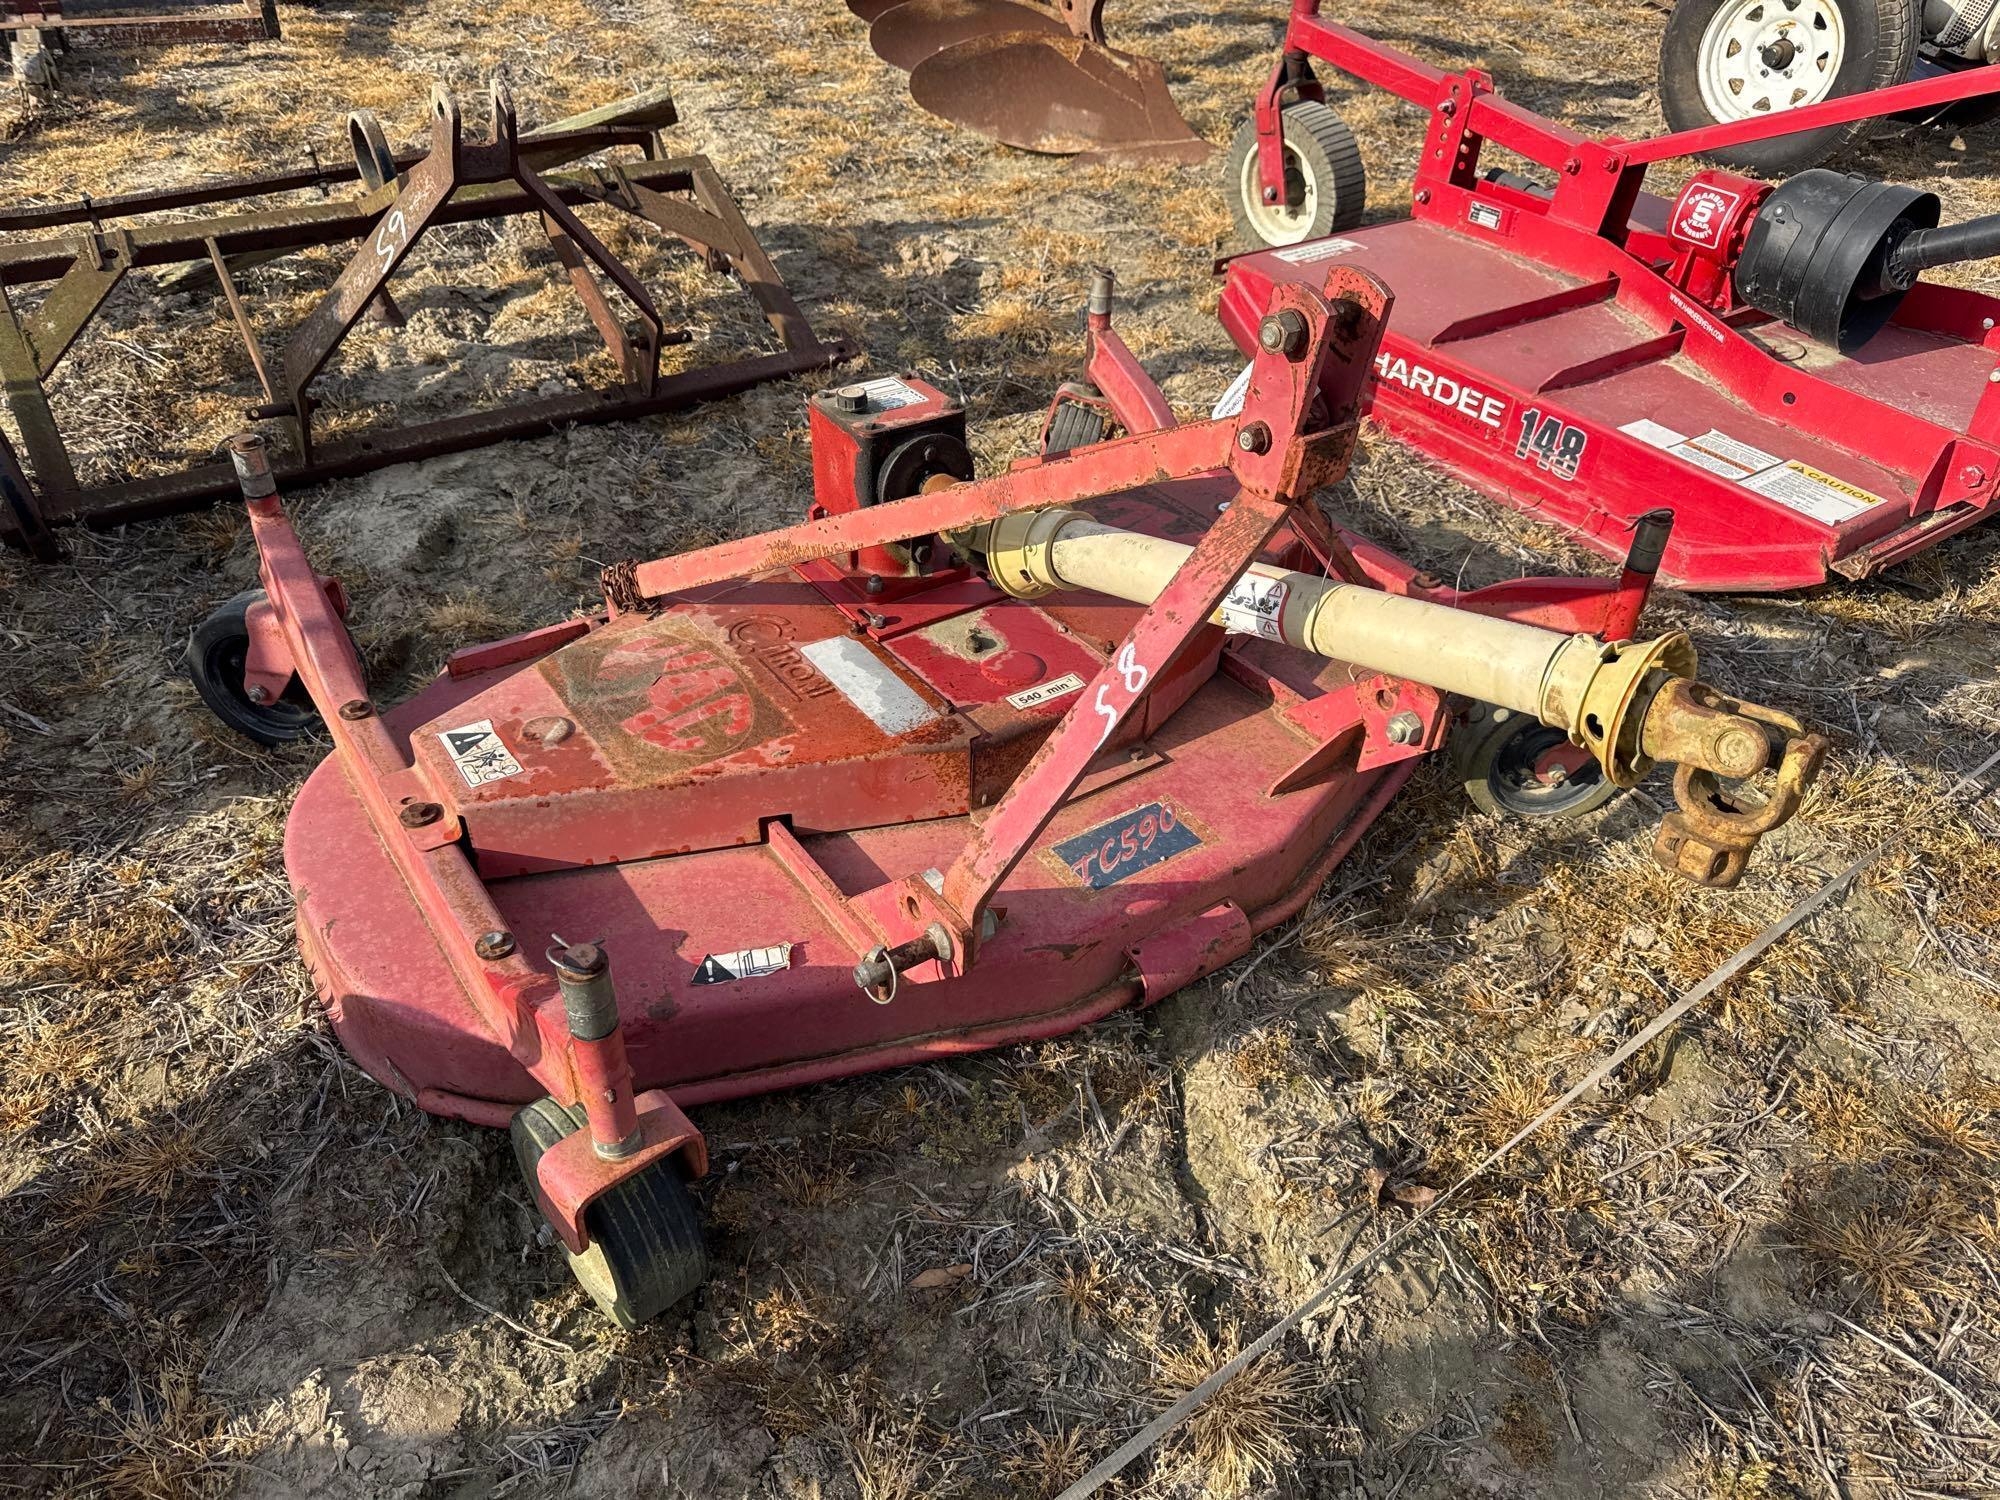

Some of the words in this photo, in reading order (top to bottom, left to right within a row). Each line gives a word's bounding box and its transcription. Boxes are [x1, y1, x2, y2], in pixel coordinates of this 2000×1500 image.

[1688, 192, 1725, 213] GEARBOX
[1692, 200, 1716, 223] 5
[1680, 220, 1713, 239] WARRANTY
[1687, 218, 1710, 230] YEAR
[376, 210, 408, 274] 59
[1374, 352, 1506, 429] HARDEE
[1514, 406, 1588, 481] 148
[1807, 472, 1877, 504] CAUTION
[1018, 691, 1042, 705] 540
[1094, 641, 1149, 751] 58
[1070, 801, 1178, 887] TC590
